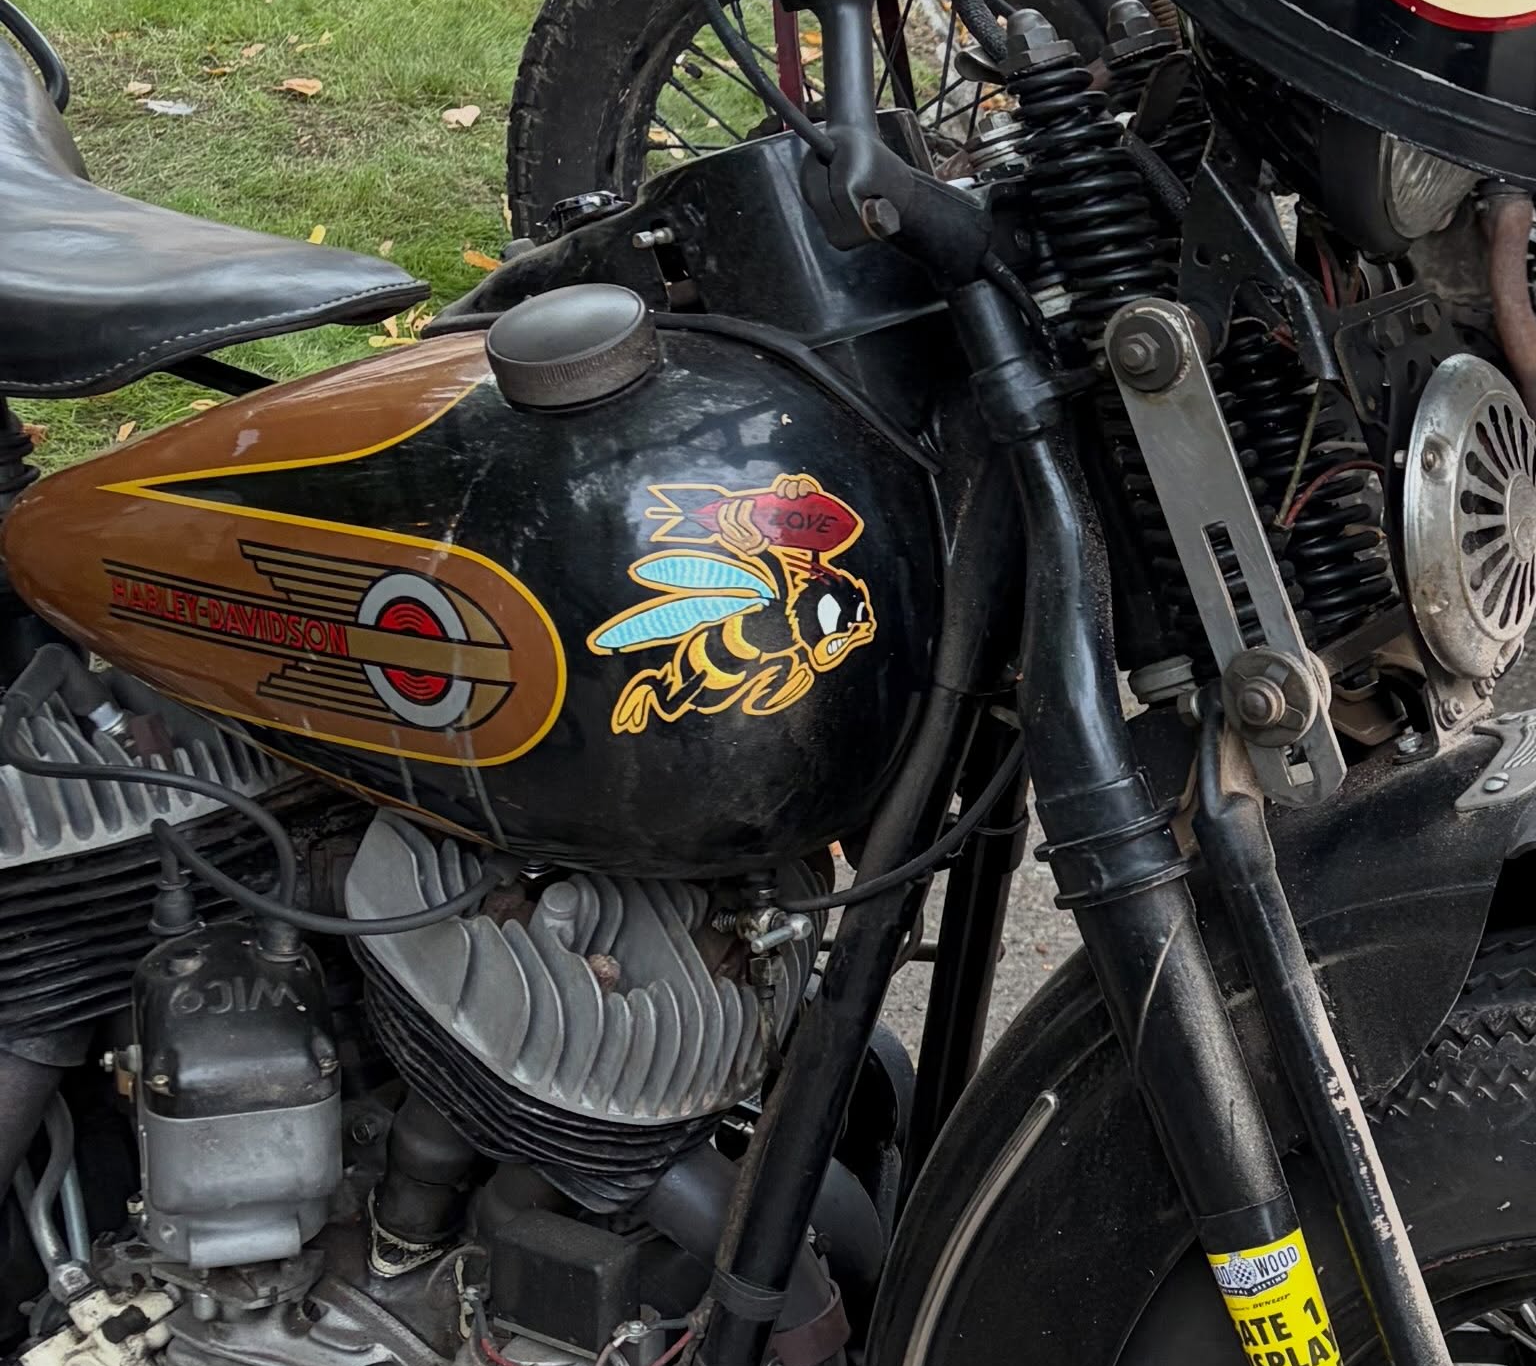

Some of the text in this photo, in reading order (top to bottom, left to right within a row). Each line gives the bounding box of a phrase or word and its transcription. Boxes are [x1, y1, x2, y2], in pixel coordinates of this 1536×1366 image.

[768, 507, 838, 534] LOVE
[110, 576, 349, 657] HARLEY-DAVIDSON
[1252, 1246, 1298, 1279] WOOD
[1236, 1296, 1322, 1347] ATE 1
